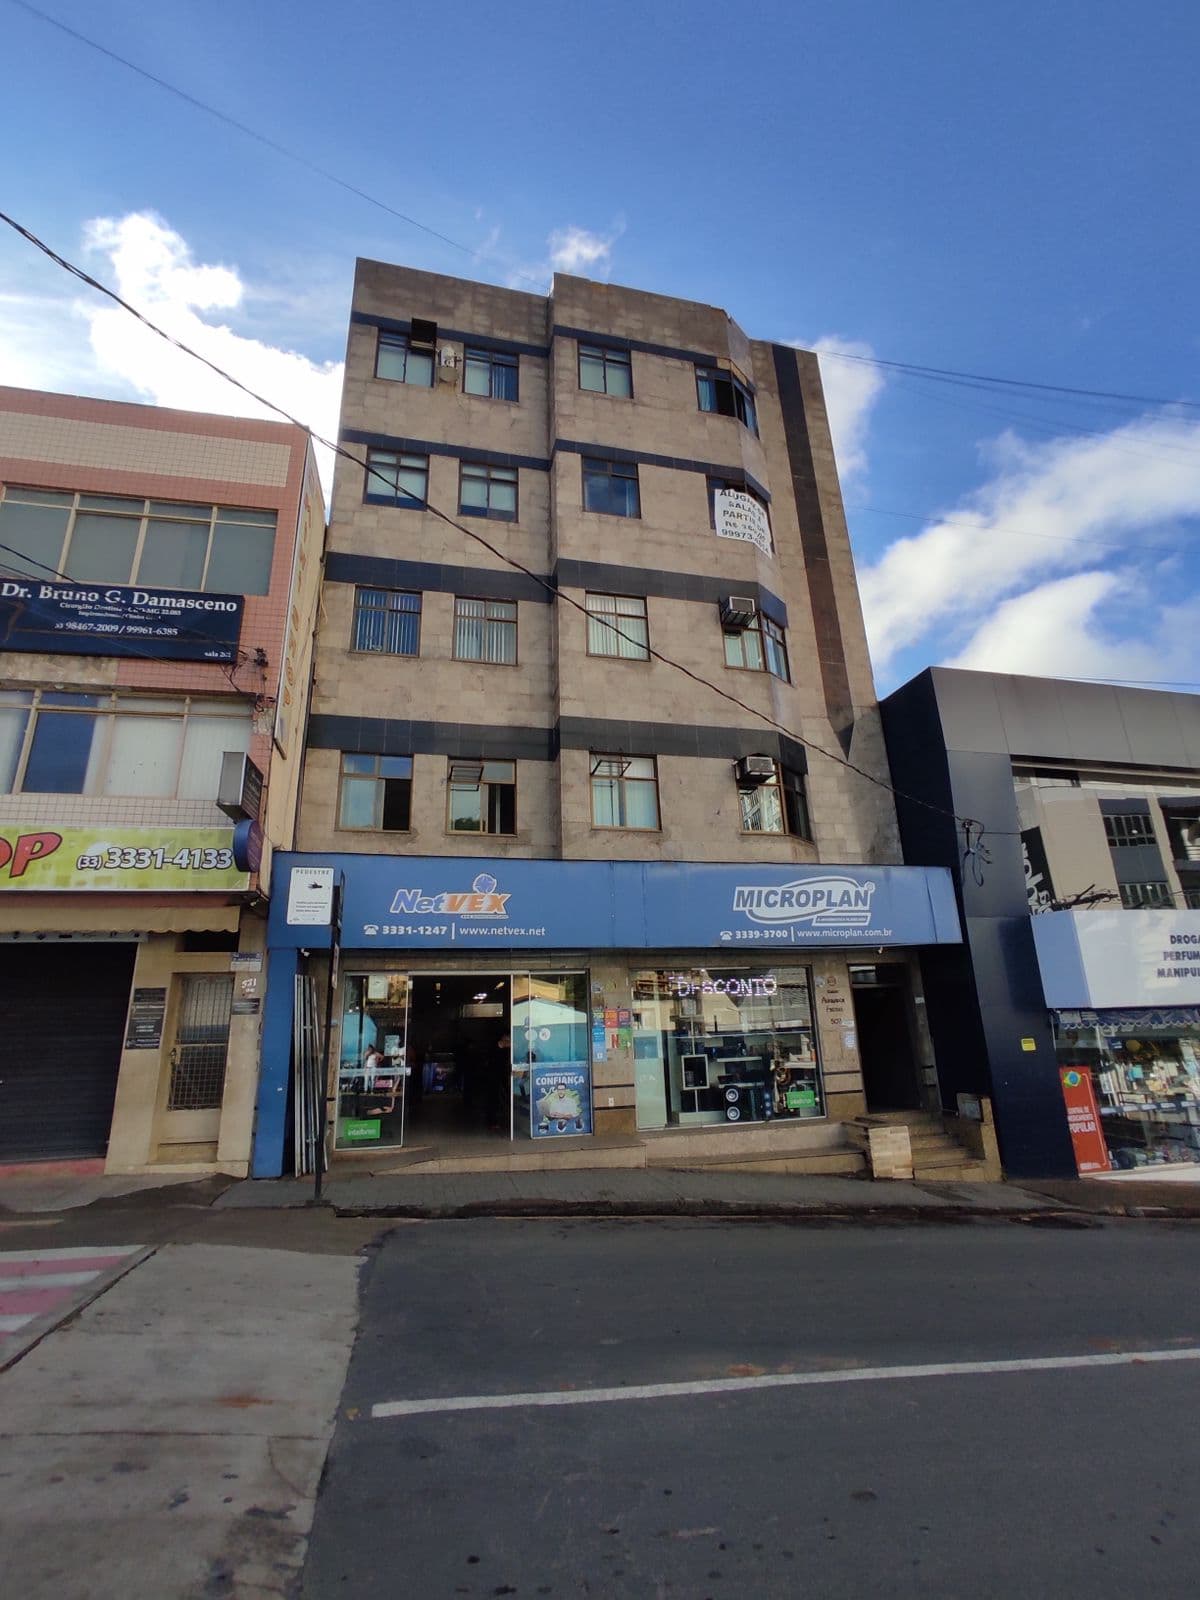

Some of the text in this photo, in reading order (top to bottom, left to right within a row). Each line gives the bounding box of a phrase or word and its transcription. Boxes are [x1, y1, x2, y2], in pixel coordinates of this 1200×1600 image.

[1, 582, 238, 612] Dr. Bruno G. Damasceno
[65, 621, 119, 632] 98467-2009
[126, 625, 179, 635] 99961-6385
[76, 854, 103, 870] (33)
[104, 846, 233, 870] 3331-4133
[734, 888, 869, 908] MICROPLAN
[382, 925, 546, 937] 3331-1247 www.netvex.net
[735, 928, 892, 939] 3339-3700 www.microplan.com.br
[1170, 934, 1200, 945] DROG
[535, 1075, 585, 1087] CONFIANÇA
